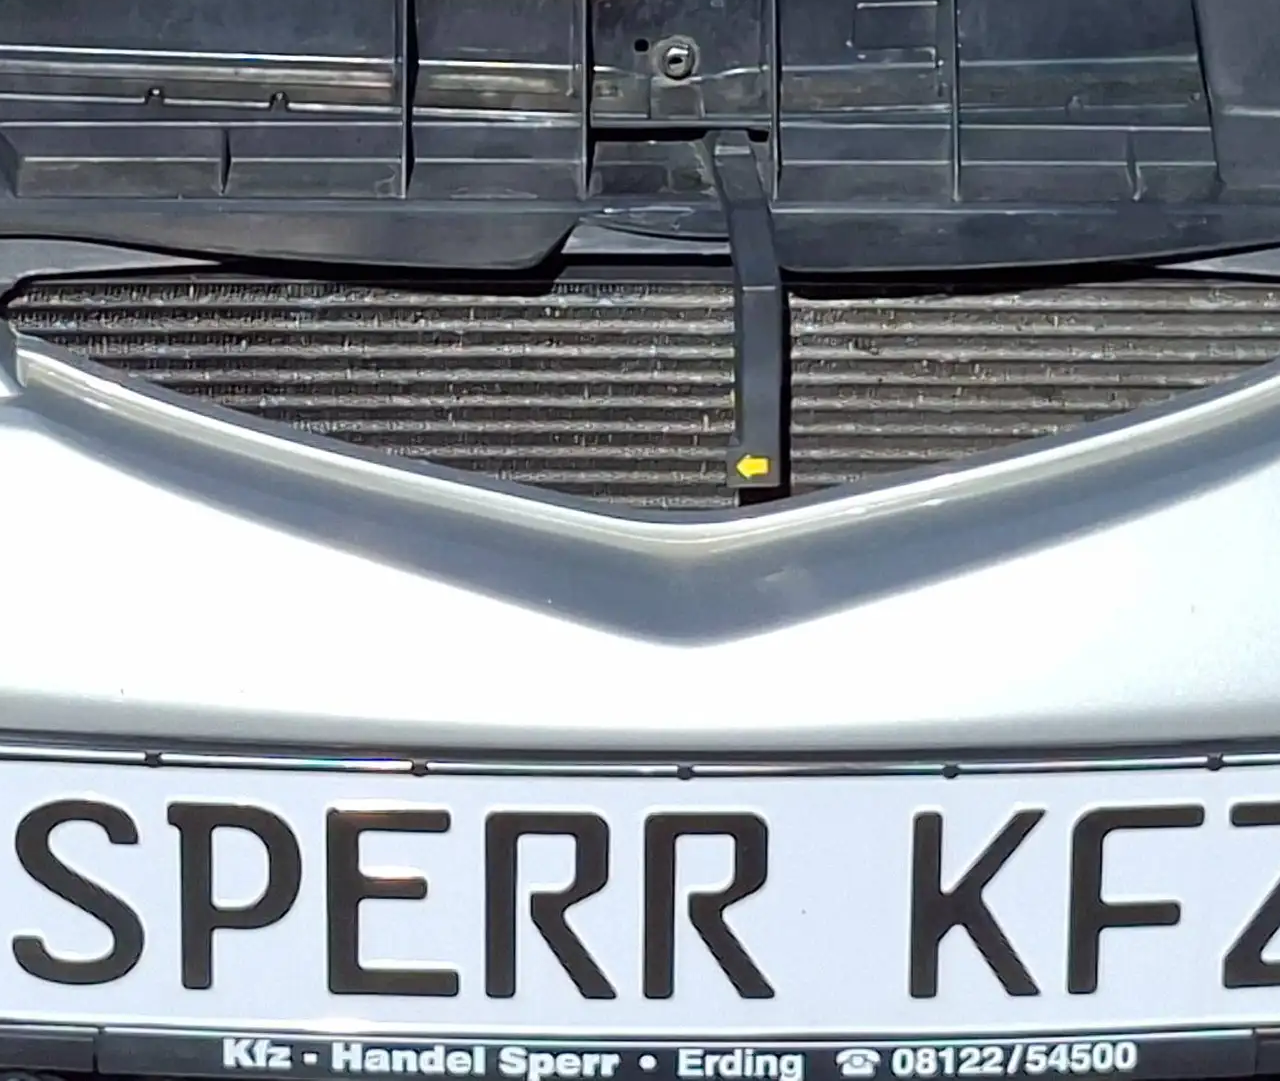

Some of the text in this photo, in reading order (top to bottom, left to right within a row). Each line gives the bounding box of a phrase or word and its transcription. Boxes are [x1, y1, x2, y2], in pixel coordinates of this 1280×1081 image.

[11, 799, 776, 1002] SPERR
[222, 1037, 293, 1070] Kfz
[330, 1041, 487, 1076] Handel
[498, 1045, 621, 1081] Sperr
[677, 1048, 804, 1081] Erding
[892, 1041, 1139, 1077] 08122/54500
